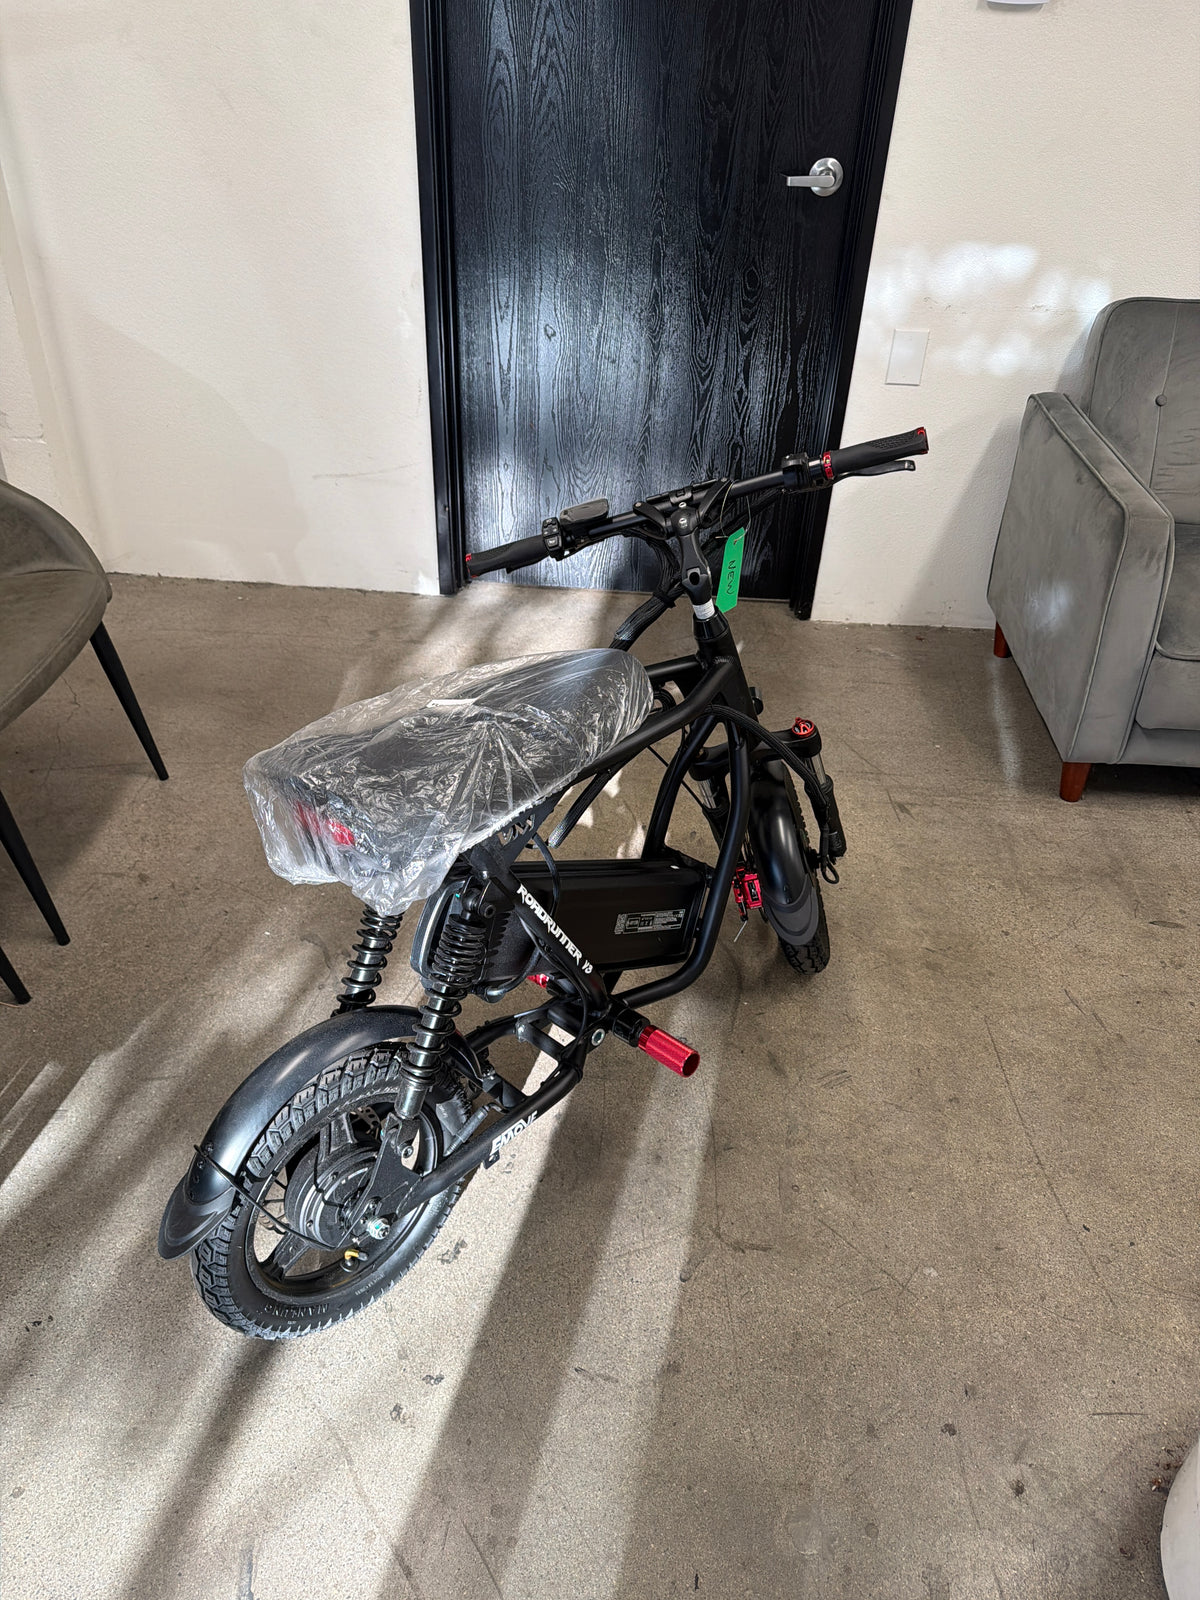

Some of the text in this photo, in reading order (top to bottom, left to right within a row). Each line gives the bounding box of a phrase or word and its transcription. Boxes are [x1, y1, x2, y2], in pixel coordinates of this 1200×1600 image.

[726, 559, 736, 595] NEW
[516, 883, 583, 966] ROADRUNNER
[489, 1110, 538, 1156] EMOVE
